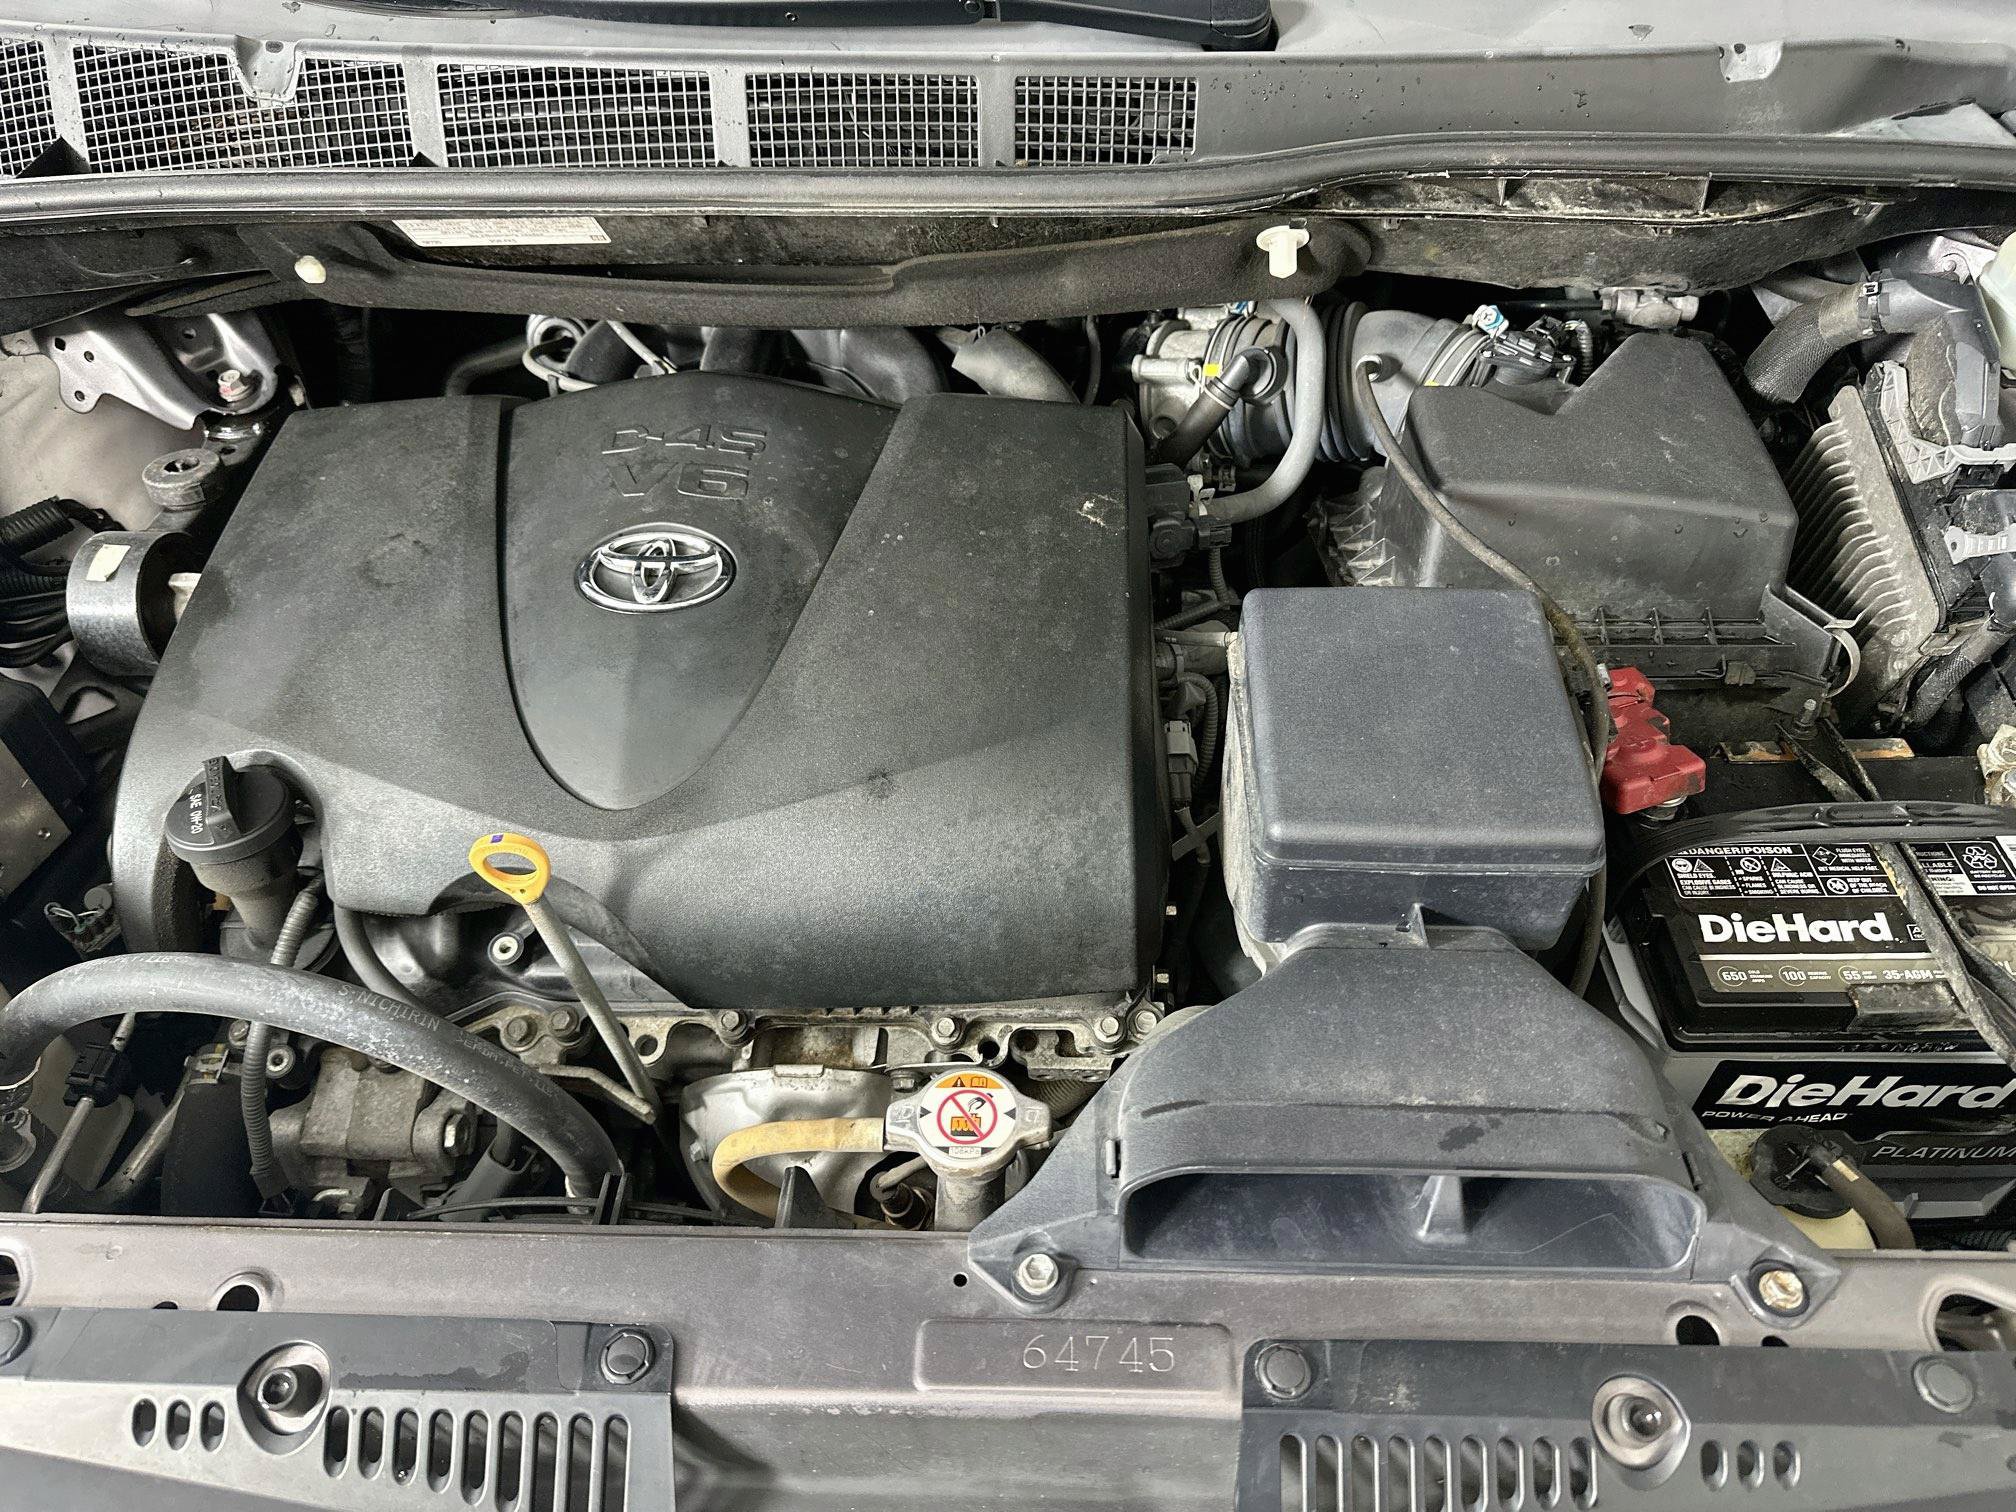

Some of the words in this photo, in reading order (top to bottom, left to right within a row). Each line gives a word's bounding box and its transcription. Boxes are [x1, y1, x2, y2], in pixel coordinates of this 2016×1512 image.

[606, 462, 750, 501] V6
[189, 793, 203, 809] SAE
[1688, 846, 1793, 855] DANGER/POISON
[1698, 912, 1894, 943] DieHard
[1721, 971, 1748, 981] 650
[1782, 971, 1806, 981] 100
[1842, 970, 1861, 980] 55
[1882, 969, 1934, 980] 35-AGM
[1715, 1073, 2016, 1108] DieHard
[1701, 1111, 1774, 1122] POWER
[1779, 1112, 1848, 1123] AHEAD
[1872, 1146, 2016, 1159] PLATINUM
[1023, 1334, 1174, 1373] 64745
